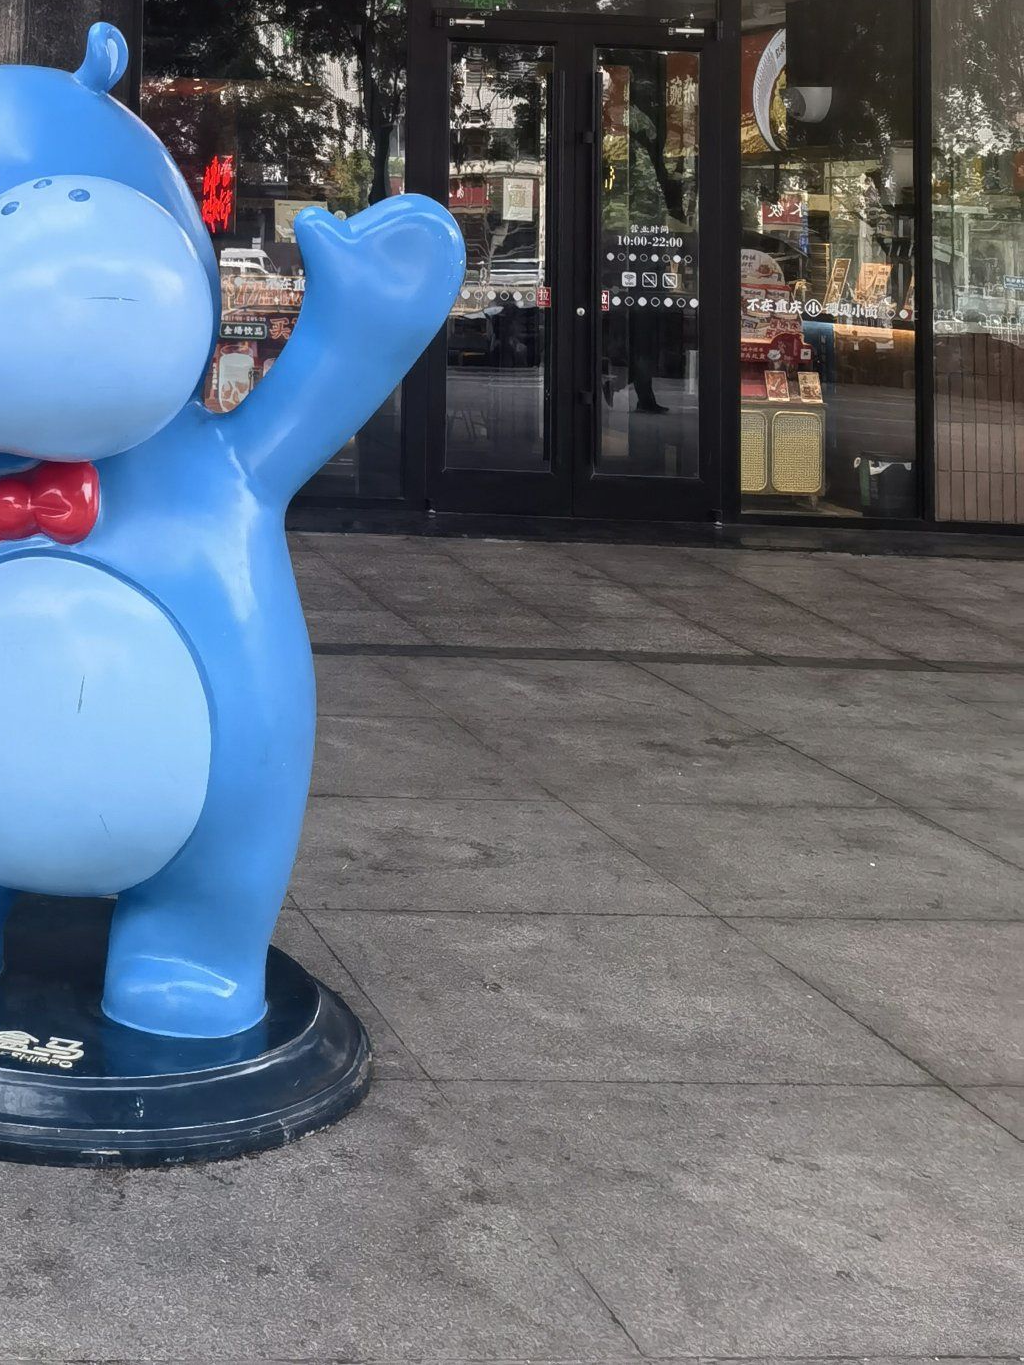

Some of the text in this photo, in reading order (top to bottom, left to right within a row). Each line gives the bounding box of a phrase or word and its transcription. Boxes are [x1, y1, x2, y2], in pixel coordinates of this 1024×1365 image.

[630, 224, 669, 234] 营业时间
[617, 235, 683, 248] 10:00-22:00
[538, 288, 550, 301] 拉
[746, 298, 804, 315] 不在重庆
[269, 317, 297, 340] 买
